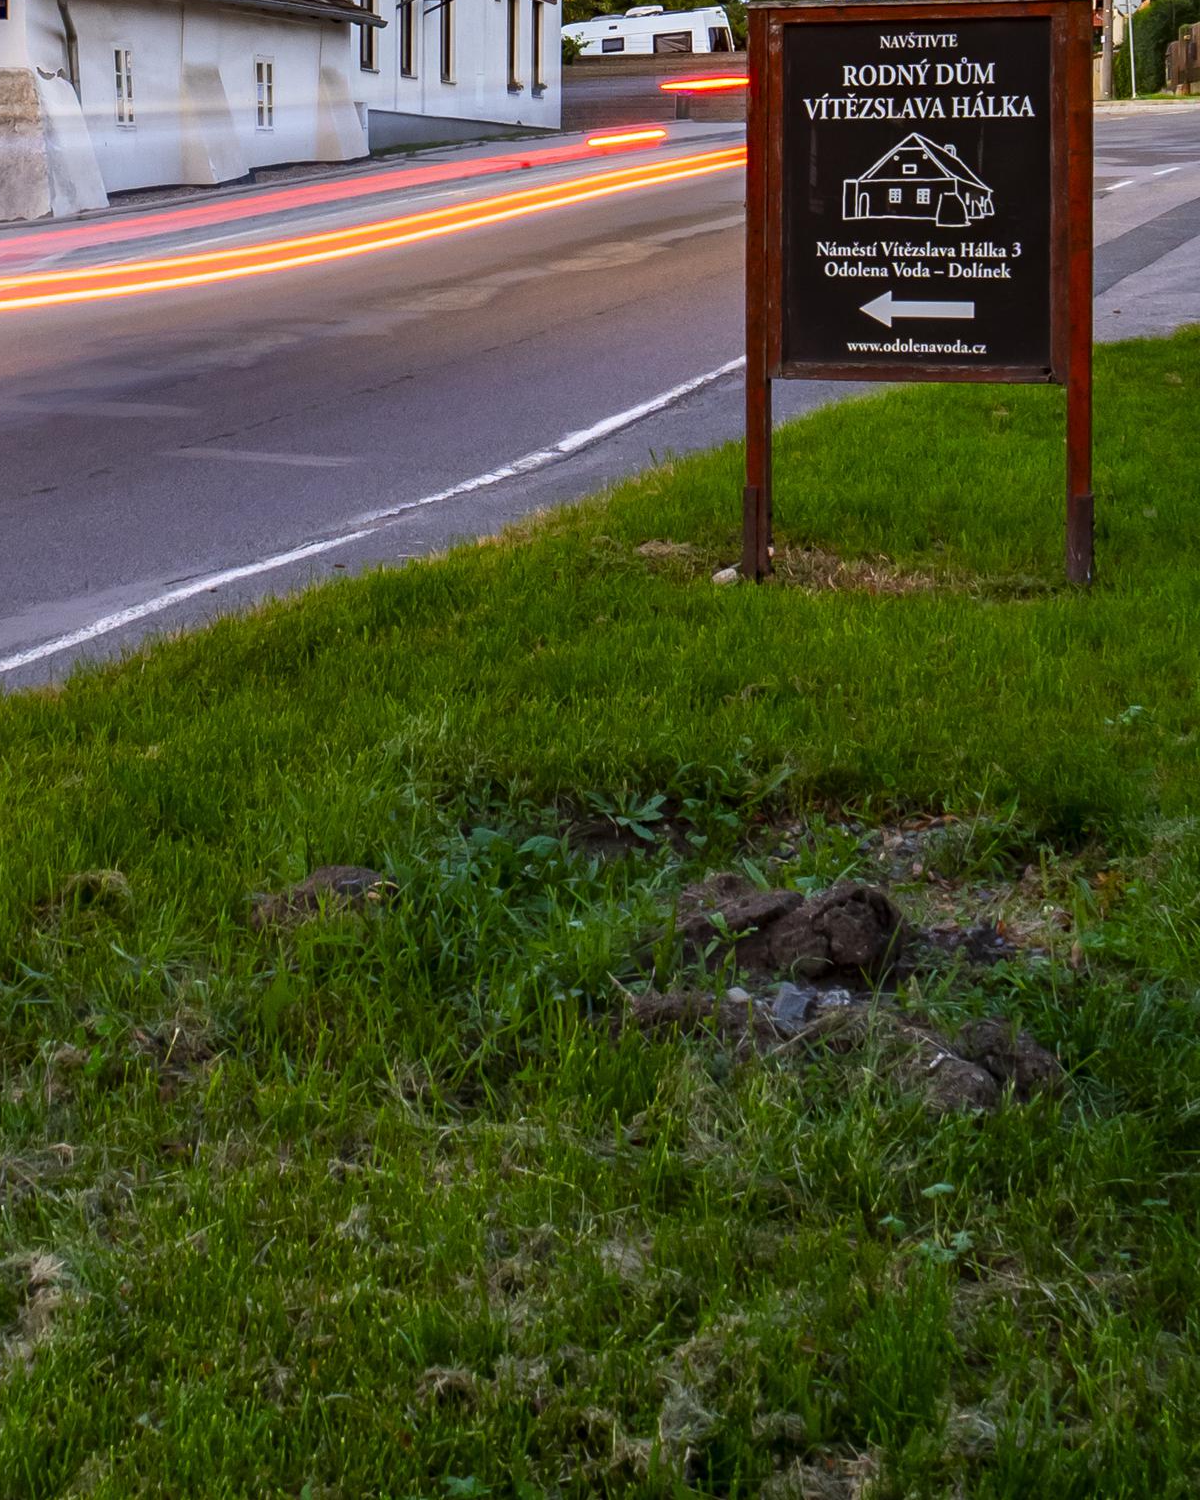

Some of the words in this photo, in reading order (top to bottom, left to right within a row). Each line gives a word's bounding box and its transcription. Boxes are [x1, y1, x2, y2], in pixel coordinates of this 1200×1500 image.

[879, 31, 958, 48] NAVŠTIVTE
[842, 58, 931, 86] RODNÝ
[935, 56, 996, 86] DŮM
[802, 92, 947, 120] VÍTĚZSLAVA
[951, 90, 1036, 119] HÁLKA
[816, 241, 878, 257] Náměstí
[880, 240, 957, 258] Vítězslava
[960, 241, 1008, 258] Hálka
[1011, 241, 1022, 258] 3
[824, 261, 889, 278] Odolena
[891, 261, 931, 278] Voda
[948, 262, 1012, 279] Dolínek
[846, 337, 987, 354] www.odolenavoda.cz
